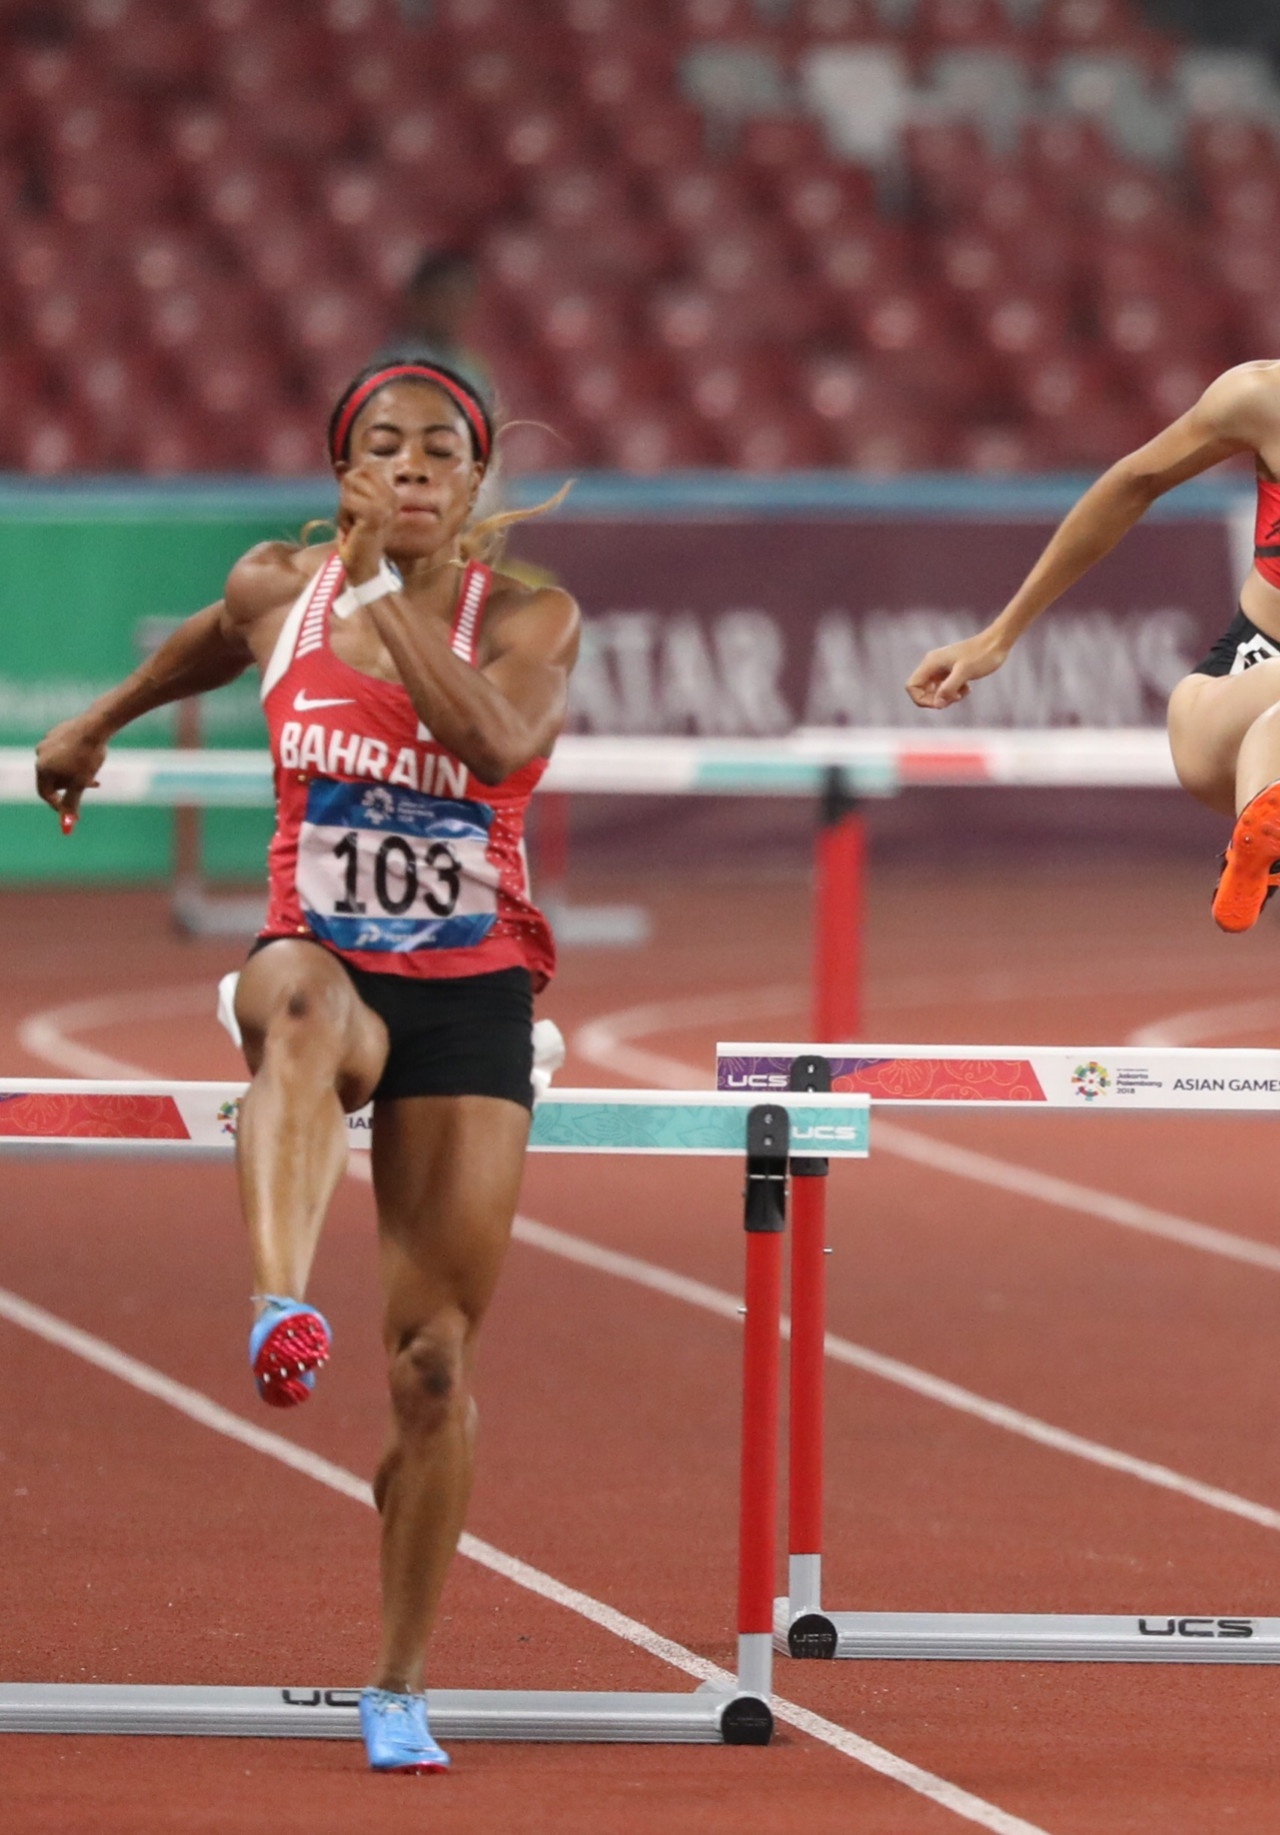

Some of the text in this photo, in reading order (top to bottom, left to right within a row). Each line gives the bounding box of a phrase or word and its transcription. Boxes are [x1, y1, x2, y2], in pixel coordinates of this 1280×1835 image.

[280, 721, 469, 798] BAHRAIN
[333, 831, 462, 917] 103
[728, 1074, 788, 1087] UCS
[1173, 1078, 1224, 1091] ASIAN
[792, 1126, 856, 1139] UCS
[1138, 1617, 1255, 1639] UCS
[282, 1688, 363, 1707] UC
